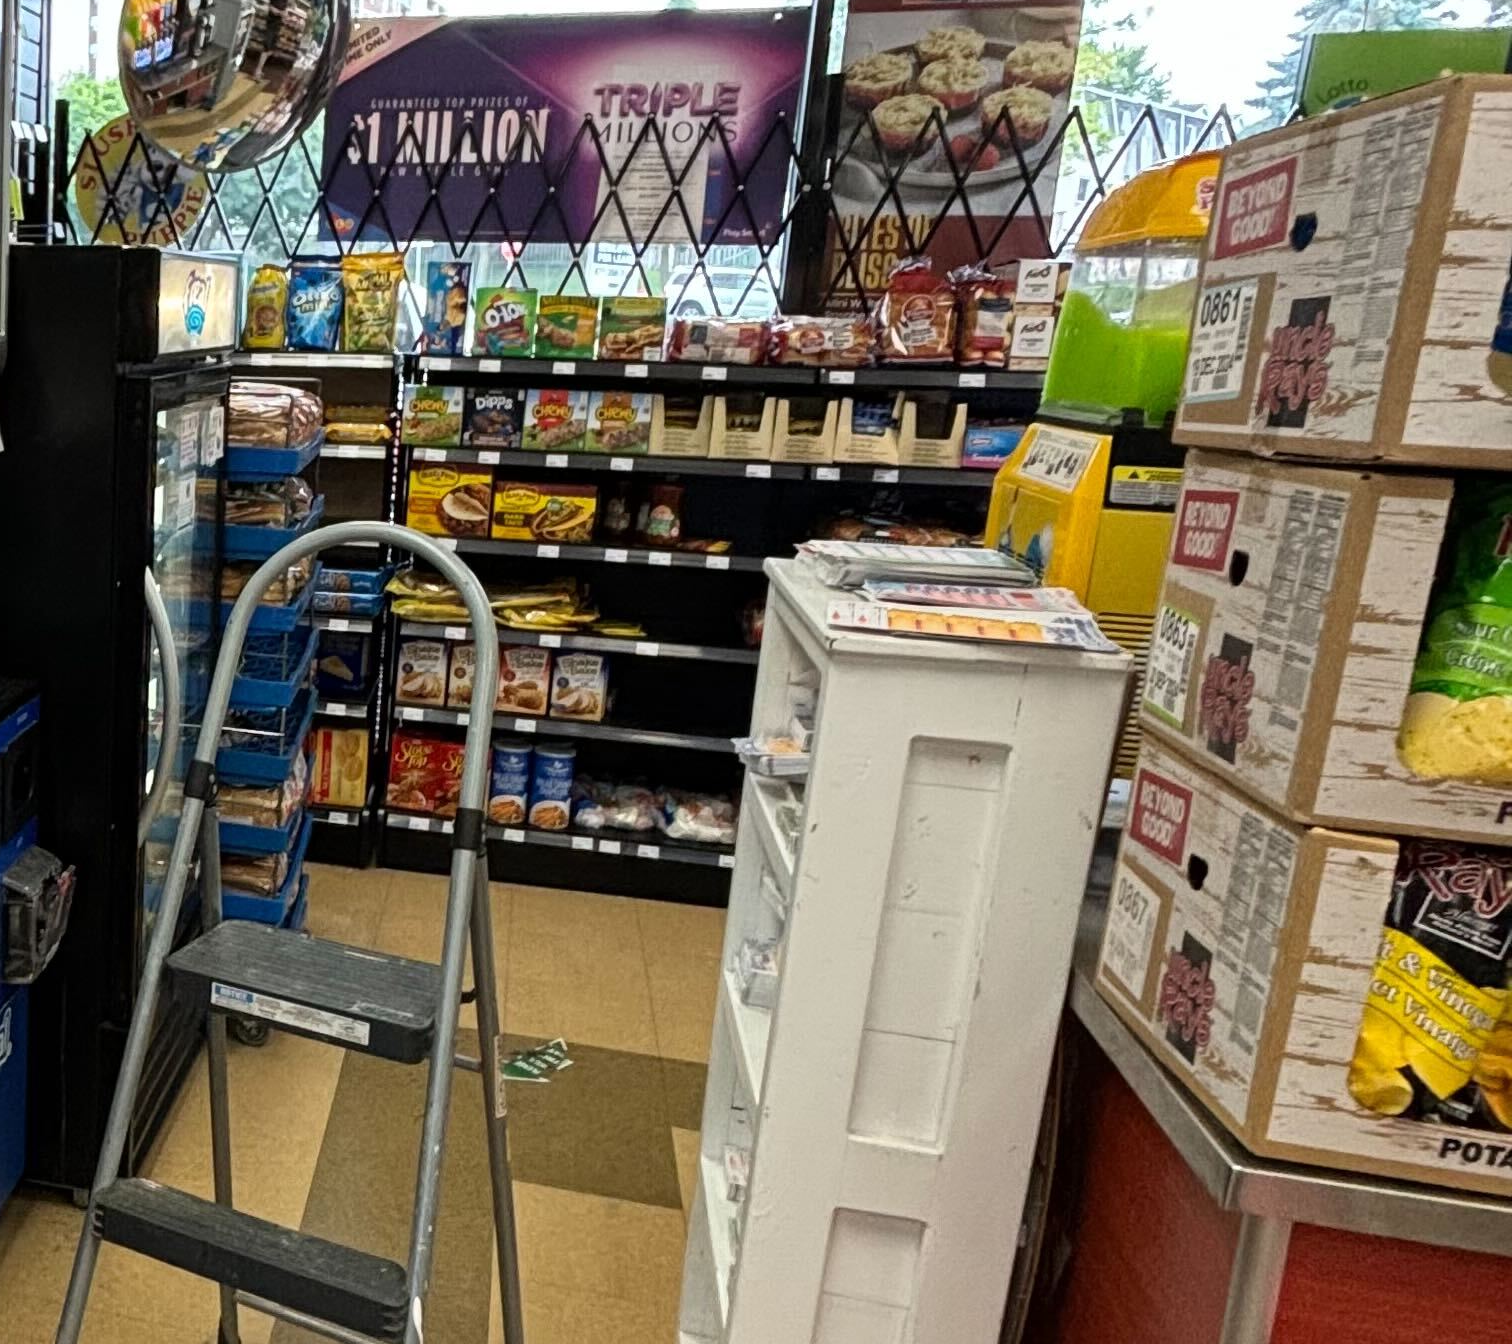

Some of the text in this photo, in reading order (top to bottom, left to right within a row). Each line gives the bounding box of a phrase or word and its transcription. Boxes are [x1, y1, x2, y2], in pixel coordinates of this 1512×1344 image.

[371, 95, 529, 109] GUARANTEED TOP PRIZES OF
[593, 81, 741, 118] TRIPLE
[1227, 171, 1288, 218] BEYOND
[1201, 287, 1241, 327] 0861
[532, 405, 573, 419] CHEWY
[596, 406, 637, 422] CHEWY
[1184, 500, 1232, 530] BEYOND
[1160, 606, 1188, 652] 0863
[1139, 780, 1186, 824] BEYOND
[1399, 952, 1422, 979] &
